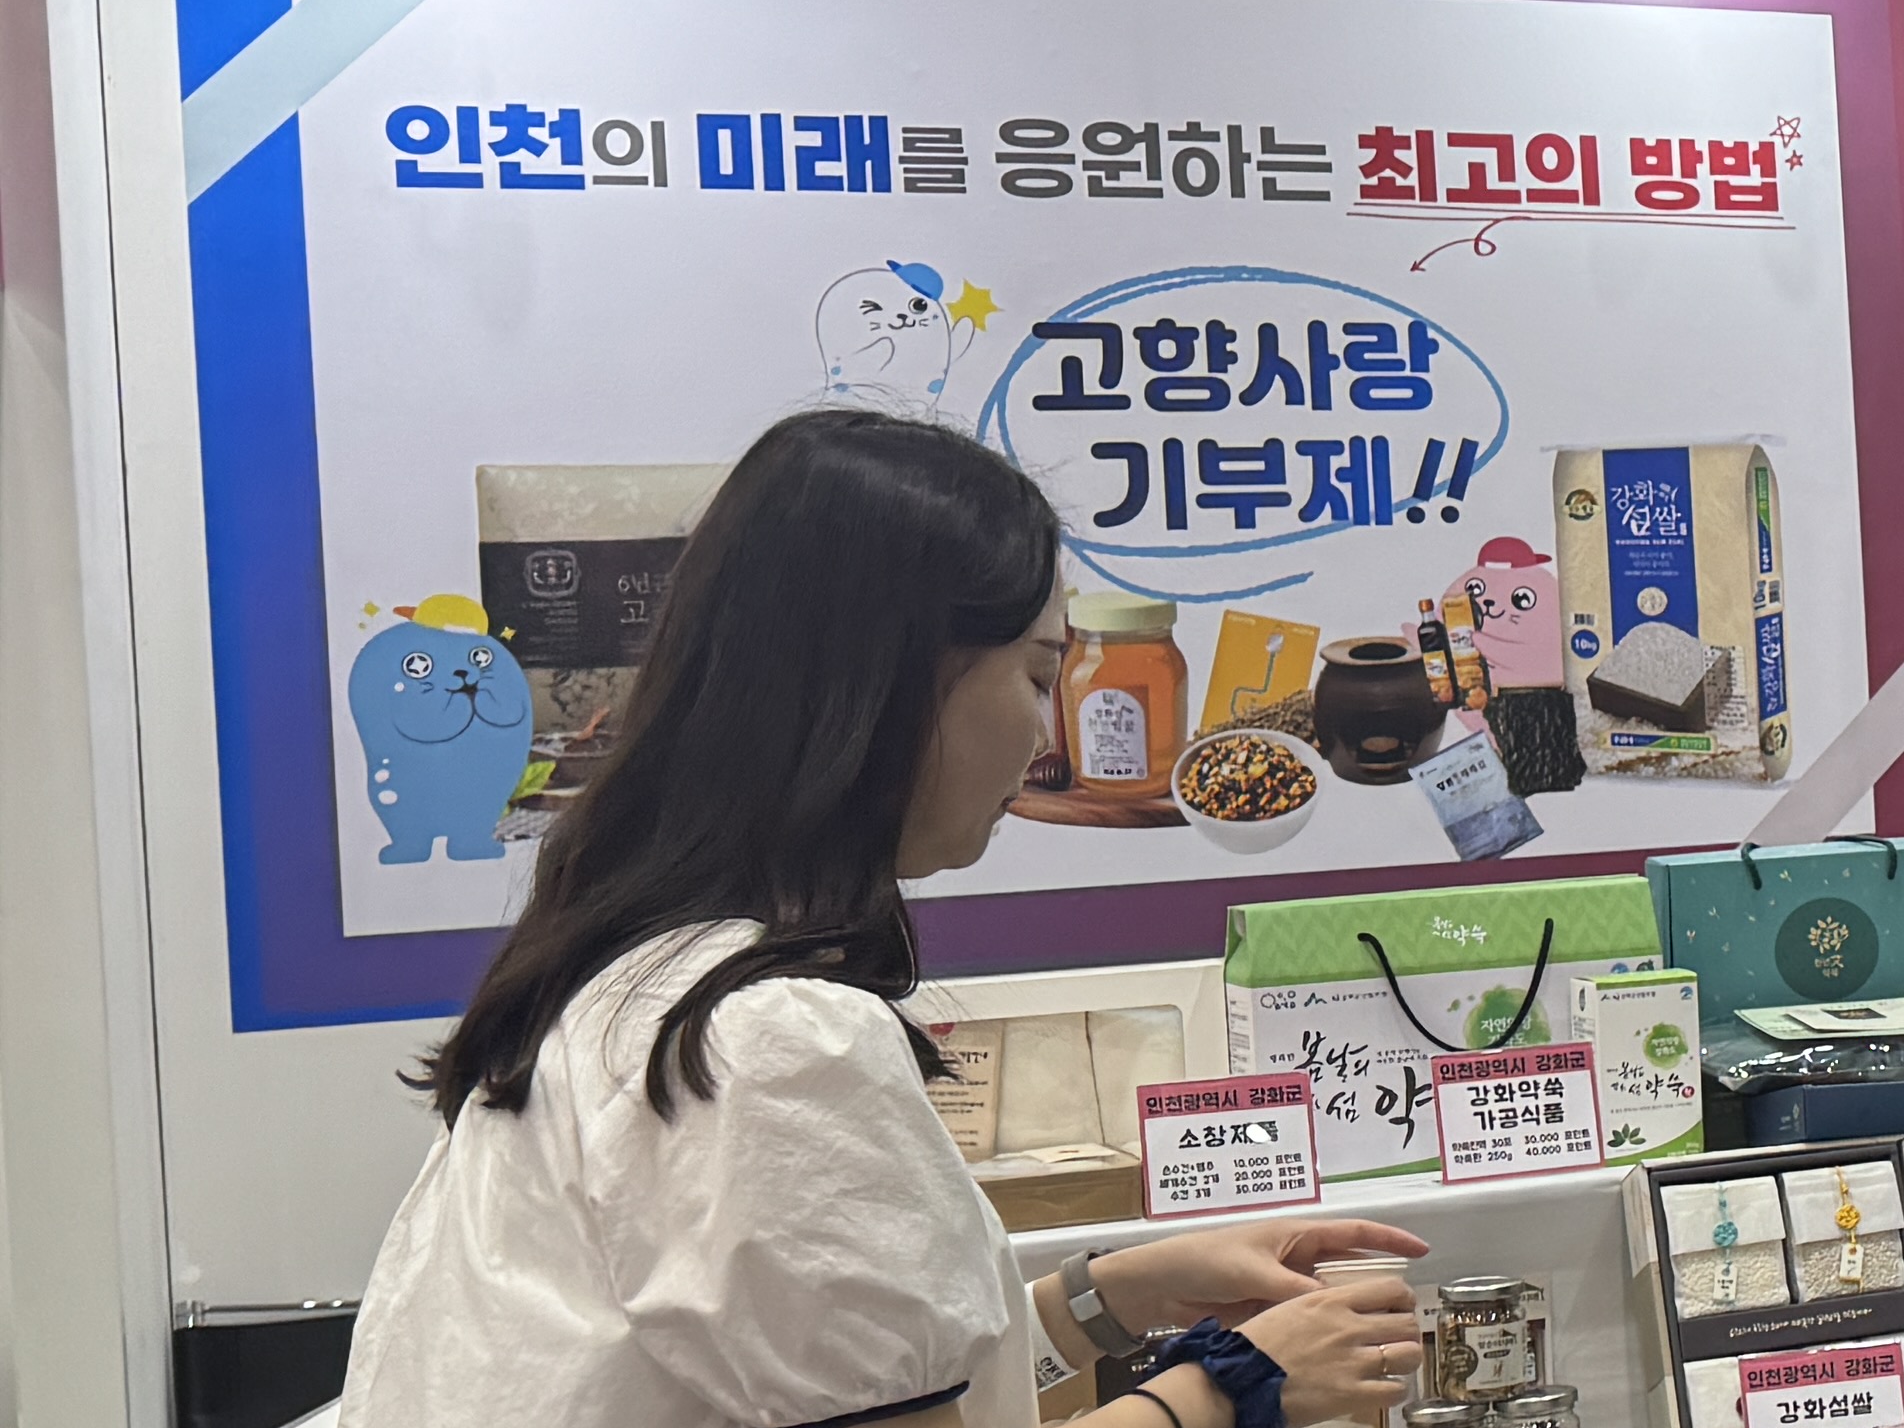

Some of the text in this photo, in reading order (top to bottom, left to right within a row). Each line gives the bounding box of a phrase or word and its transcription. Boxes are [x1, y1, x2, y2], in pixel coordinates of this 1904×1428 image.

[385, 104, 1779, 212] 인천의 미래를 응원하는 최고의 방법
[1032, 319, 1440, 412] 고향사랑
[1091, 435, 1479, 530] 기부제!!
[1611, 480, 1654, 509] 강화
[1440, 1051, 1586, 1081] 인천광역시 강화군
[1146, 1085, 1303, 1115] 인천광역시 강화군
[1467, 1077, 1565, 1107] 강화약쑥
[1473, 1103, 1565, 1131] 가공식품
[1747, 1354, 1896, 1389] 인천광역시 강화군
[1776, 1391, 1874, 1425] 강화섬쌀
